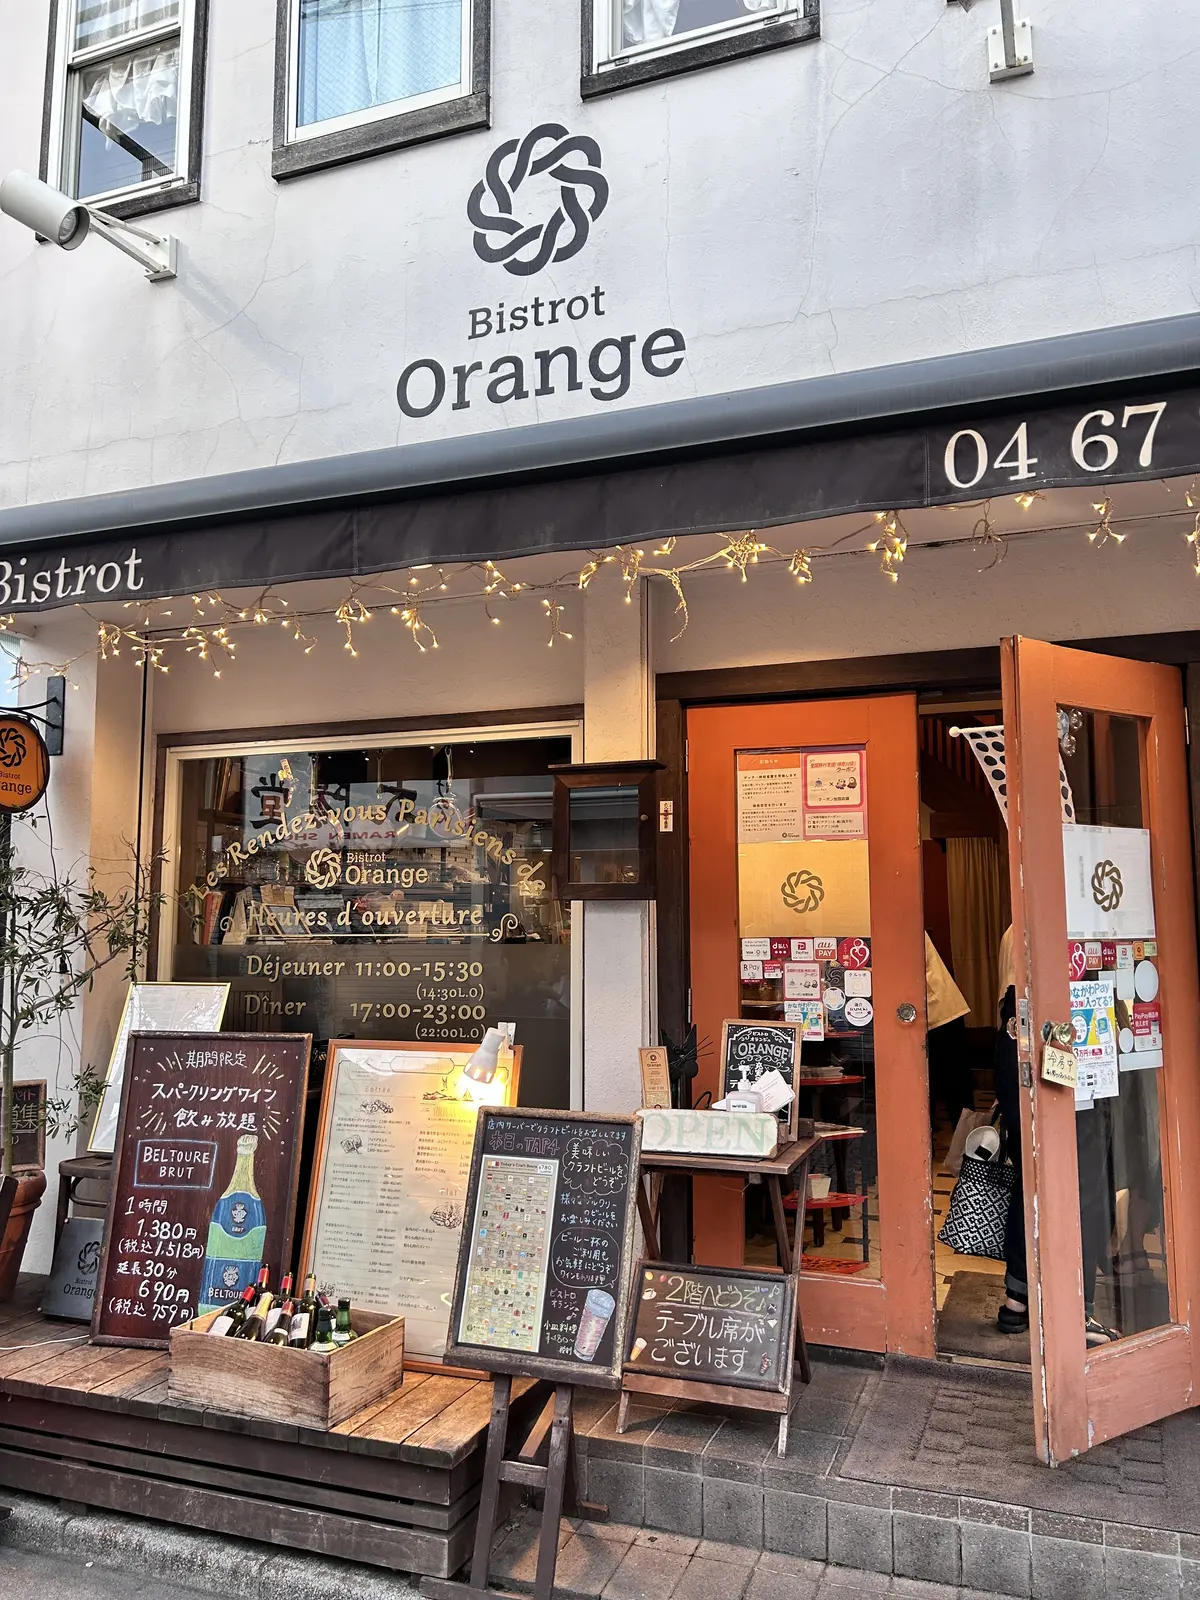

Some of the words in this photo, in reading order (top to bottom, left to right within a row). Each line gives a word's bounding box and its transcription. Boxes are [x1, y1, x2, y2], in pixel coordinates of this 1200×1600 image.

[468, 286, 605, 340] Bistrot
[396, 327, 686, 418] Orange
[944, 421, 1038, 489] 04
[1071, 401, 1167, 472] 67
[0, 548, 144, 605] Bistrot
[0, 781, 32, 796] ange
[189, 861, 228, 900] Les
[226, 800, 388, 866] Rendez-vous
[399, 799, 518, 866] Parisiens
[347, 852, 387, 864] Bistrot
[345, 865, 429, 888] Orange
[248, 905, 328, 928] Heures
[817, 941, 833, 949] au
[818, 949, 833, 957] PAY
[246, 955, 345, 983] Déjeuner
[354, 960, 483, 982] 11:00-15:30
[1088, 957, 1099, 966] PAY
[416, 982, 484, 1001] (14:30L.O)
[245, 994, 307, 1017] Dîner
[350, 1002, 486, 1024] 17:00-23:00
[186, 1050, 248, 1068] 期間限定
[738, 1042, 789, 1061] ORANGE
[151, 1083, 277, 1103] スパークリングワイン
[174, 1107, 259, 1132] 飲み放題
[644, 1112, 772, 1153] OPEN
[143, 1146, 211, 1164] BELTOURE
[571, 1142, 610, 1160] 美味しい
[159, 1166, 194, 1179] BRUT
[568, 1161, 624, 1178] クラフトビールを
[593, 1175, 619, 1189] どうぞ
[137, 1218, 198, 1240] 1,380円
[116, 1259, 178, 1280] 延長30分
[138, 1279, 190, 1303] 690円
[550, 1288, 577, 1300] ビストロ
[665, 1275, 762, 1312] 2階へどうぞ
[656, 1310, 766, 1344] テーブル席が
[651, 1337, 749, 1375] ございます
